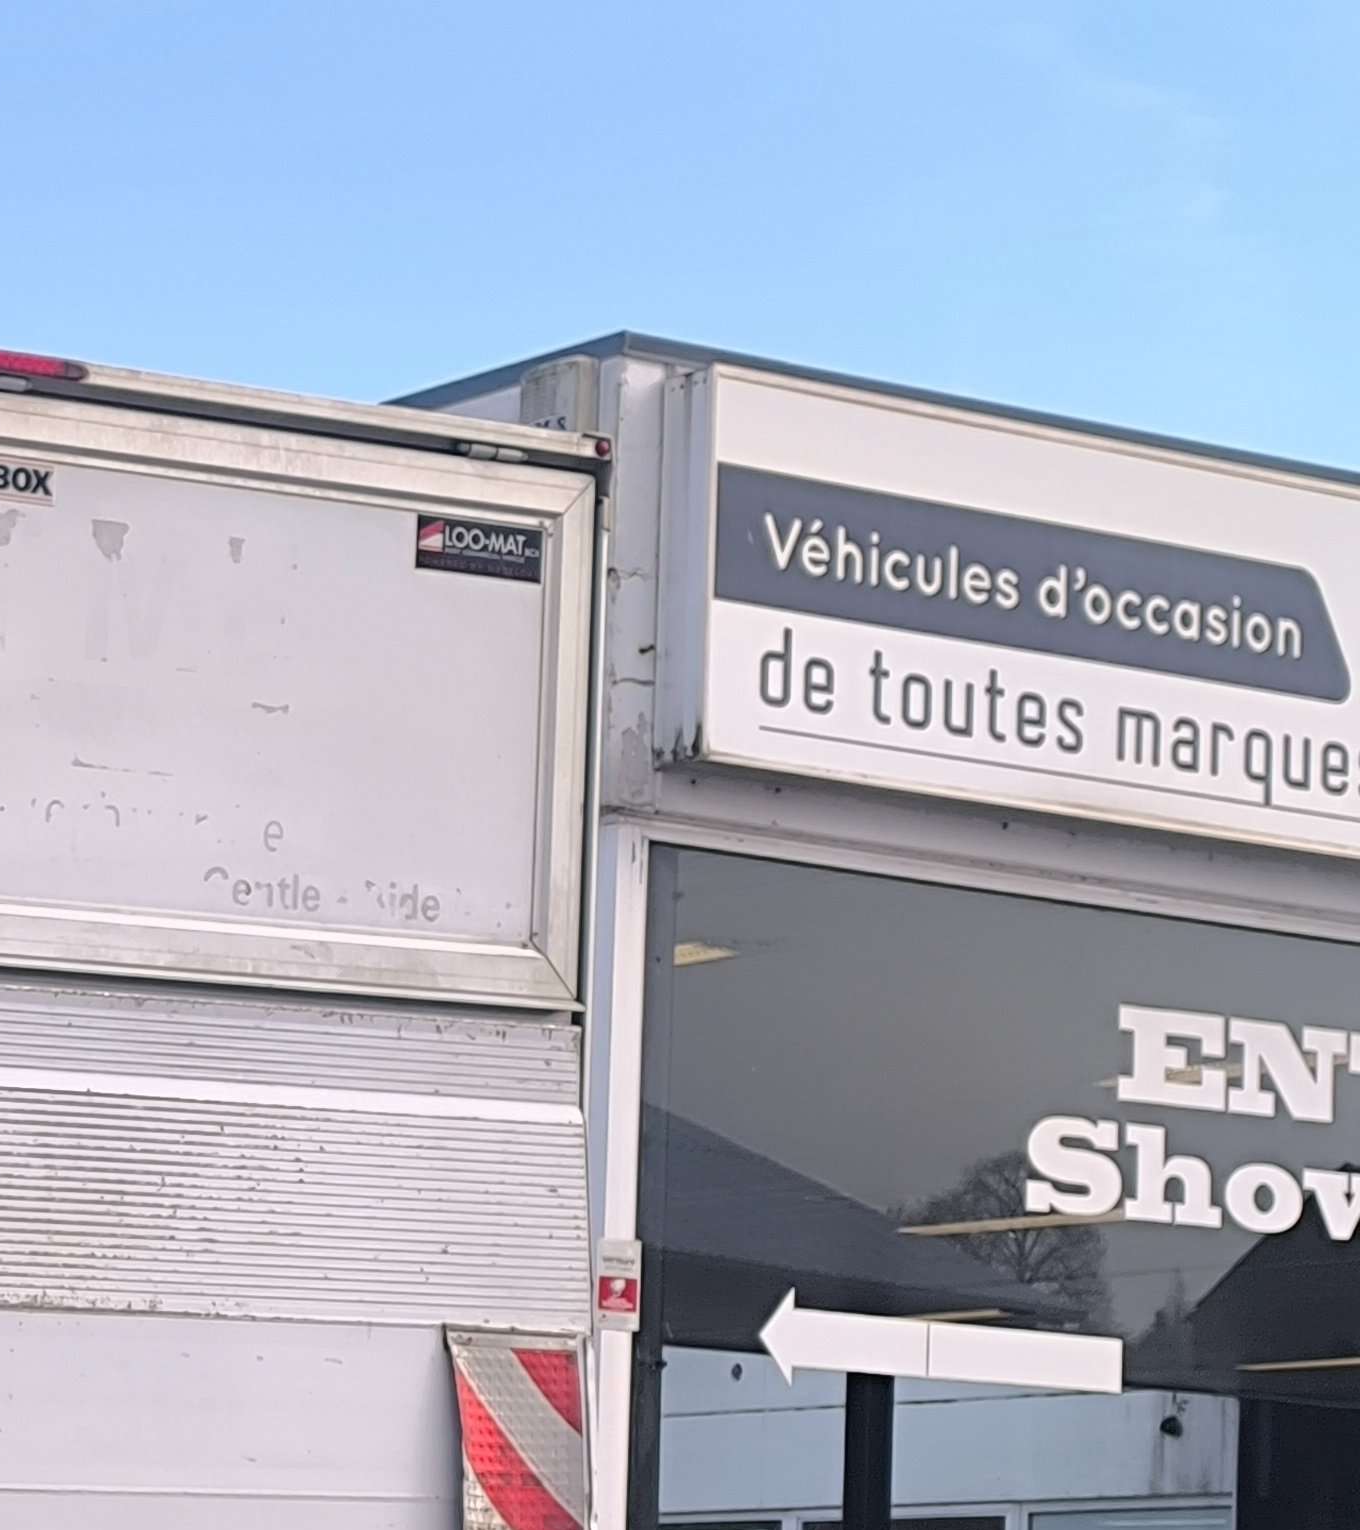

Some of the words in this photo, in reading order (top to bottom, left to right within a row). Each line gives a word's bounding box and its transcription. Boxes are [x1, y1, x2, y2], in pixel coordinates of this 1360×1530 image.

[444, 524, 528, 556] LOO-MAT
[764, 512, 1021, 609] Véhicules
[1037, 564, 1304, 660] d'occasion
[759, 627, 836, 716] de
[869, 649, 1084, 755] toutes
[1116, 705, 1360, 807] marque
[1117, 1002, 1360, 1124] EN
